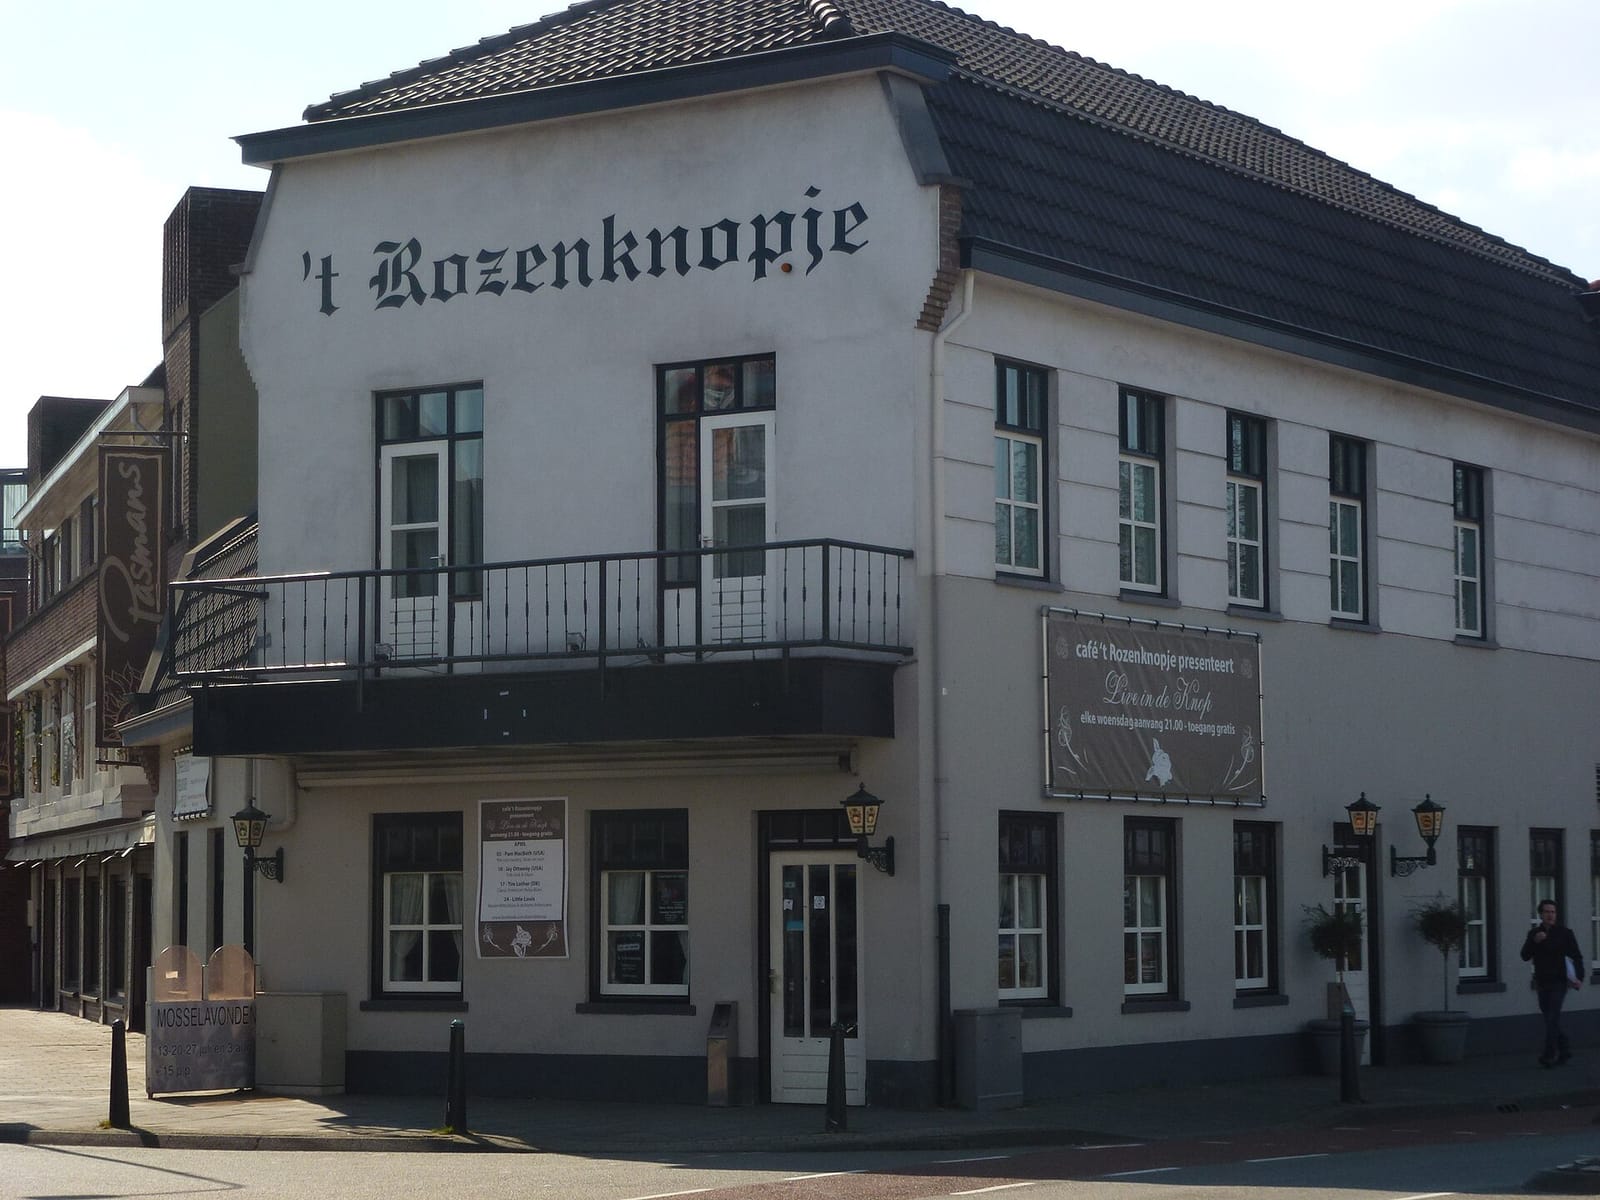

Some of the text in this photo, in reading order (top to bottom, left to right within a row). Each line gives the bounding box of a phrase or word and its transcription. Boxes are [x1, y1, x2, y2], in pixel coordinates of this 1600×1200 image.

[369, 185, 869, 312] Rozenknopje
[101, 461, 163, 643] Pasmans
[1075, 640, 1099, 660] café
[1109, 643, 1176, 672] Rozenknopje
[1178, 655, 1235, 674] presenteert
[1103, 670, 1213, 721] Live in de Knop
[1080, 711, 1097, 725] elke
[1164, 719, 1183, 731] 21.00
[1188, 721, 1216, 736] toegang
[1216, 722, 1236, 736] gratis
[157, 1006, 256, 1028] MOSSELAVONDEN
